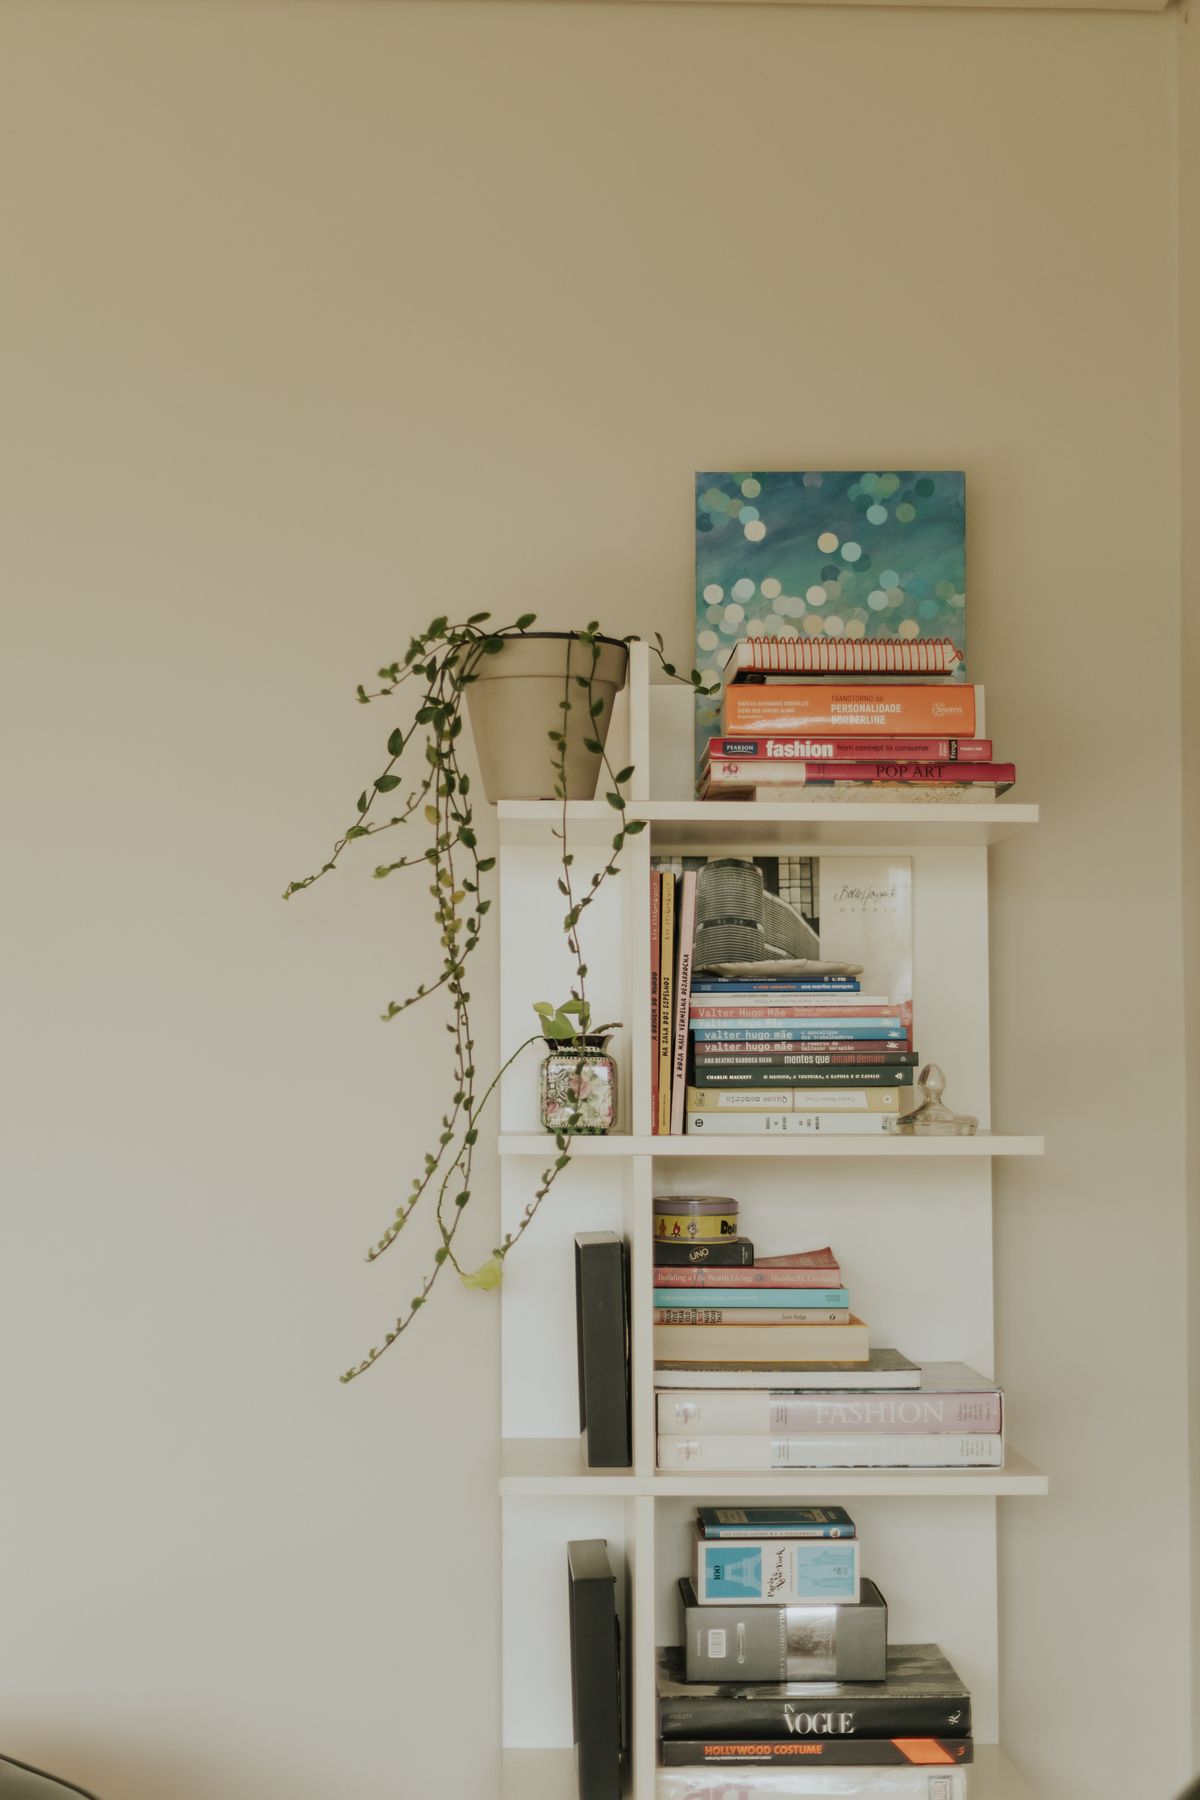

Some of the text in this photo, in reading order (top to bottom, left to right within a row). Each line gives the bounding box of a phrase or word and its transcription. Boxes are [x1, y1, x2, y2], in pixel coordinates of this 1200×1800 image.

[831, 704, 902, 713] PERSONALIDADE
[831, 715, 886, 724] BORDERLINE
[766, 740, 833, 757] fashion
[876, 766, 946, 778] POP ART
[681, 954, 689, 996] DESABROCHA
[651, 998, 658, 1006] DO
[678, 998, 687, 1032] VERMELHA
[698, 1008, 786, 1018] Valter Hugo Mãe
[737, 1019, 762, 1027] Hugo
[704, 1030, 793, 1040] valter hugo mãe
[662, 1047, 668, 1057] NA
[705, 1042, 793, 1052] valter hugo mãe
[784, 1055, 886, 1065] mentes que amam demais
[726, 1096, 788, 1104] Quase memória
[689, 1248, 709, 1260] UNO
[731, 1274, 753, 1282] Living
[816, 1401, 944, 1423] FASHION
[776, 1546, 786, 1588] New York
[767, 1577, 776, 1597] Paris
[784, 1704, 795, 1713] IN
[783, 1712, 854, 1734] VOGUE
[704, 1744, 823, 1755] HOLLYWOOD COSTUME
